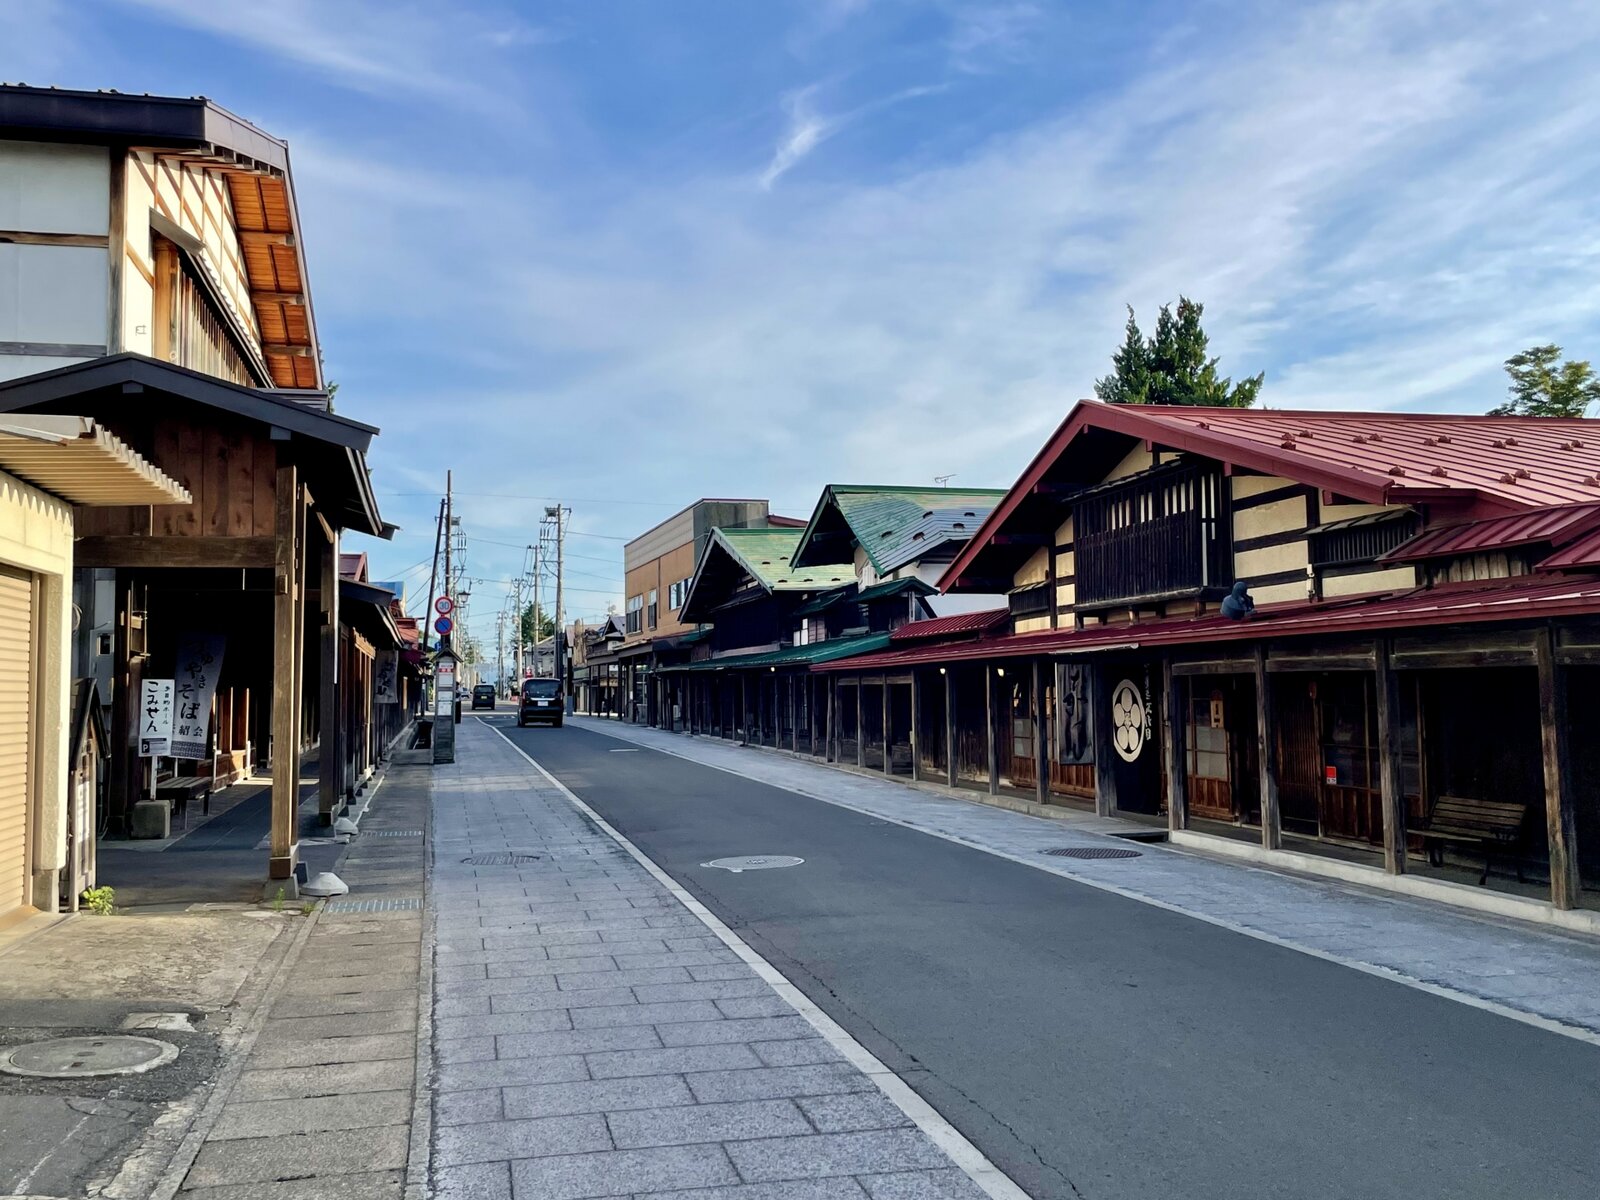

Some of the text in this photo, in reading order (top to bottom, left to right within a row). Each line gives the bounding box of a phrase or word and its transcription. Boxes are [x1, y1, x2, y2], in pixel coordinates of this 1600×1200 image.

[440, 602, 449, 610] 30
[146, 681, 160, 732] こみせん
